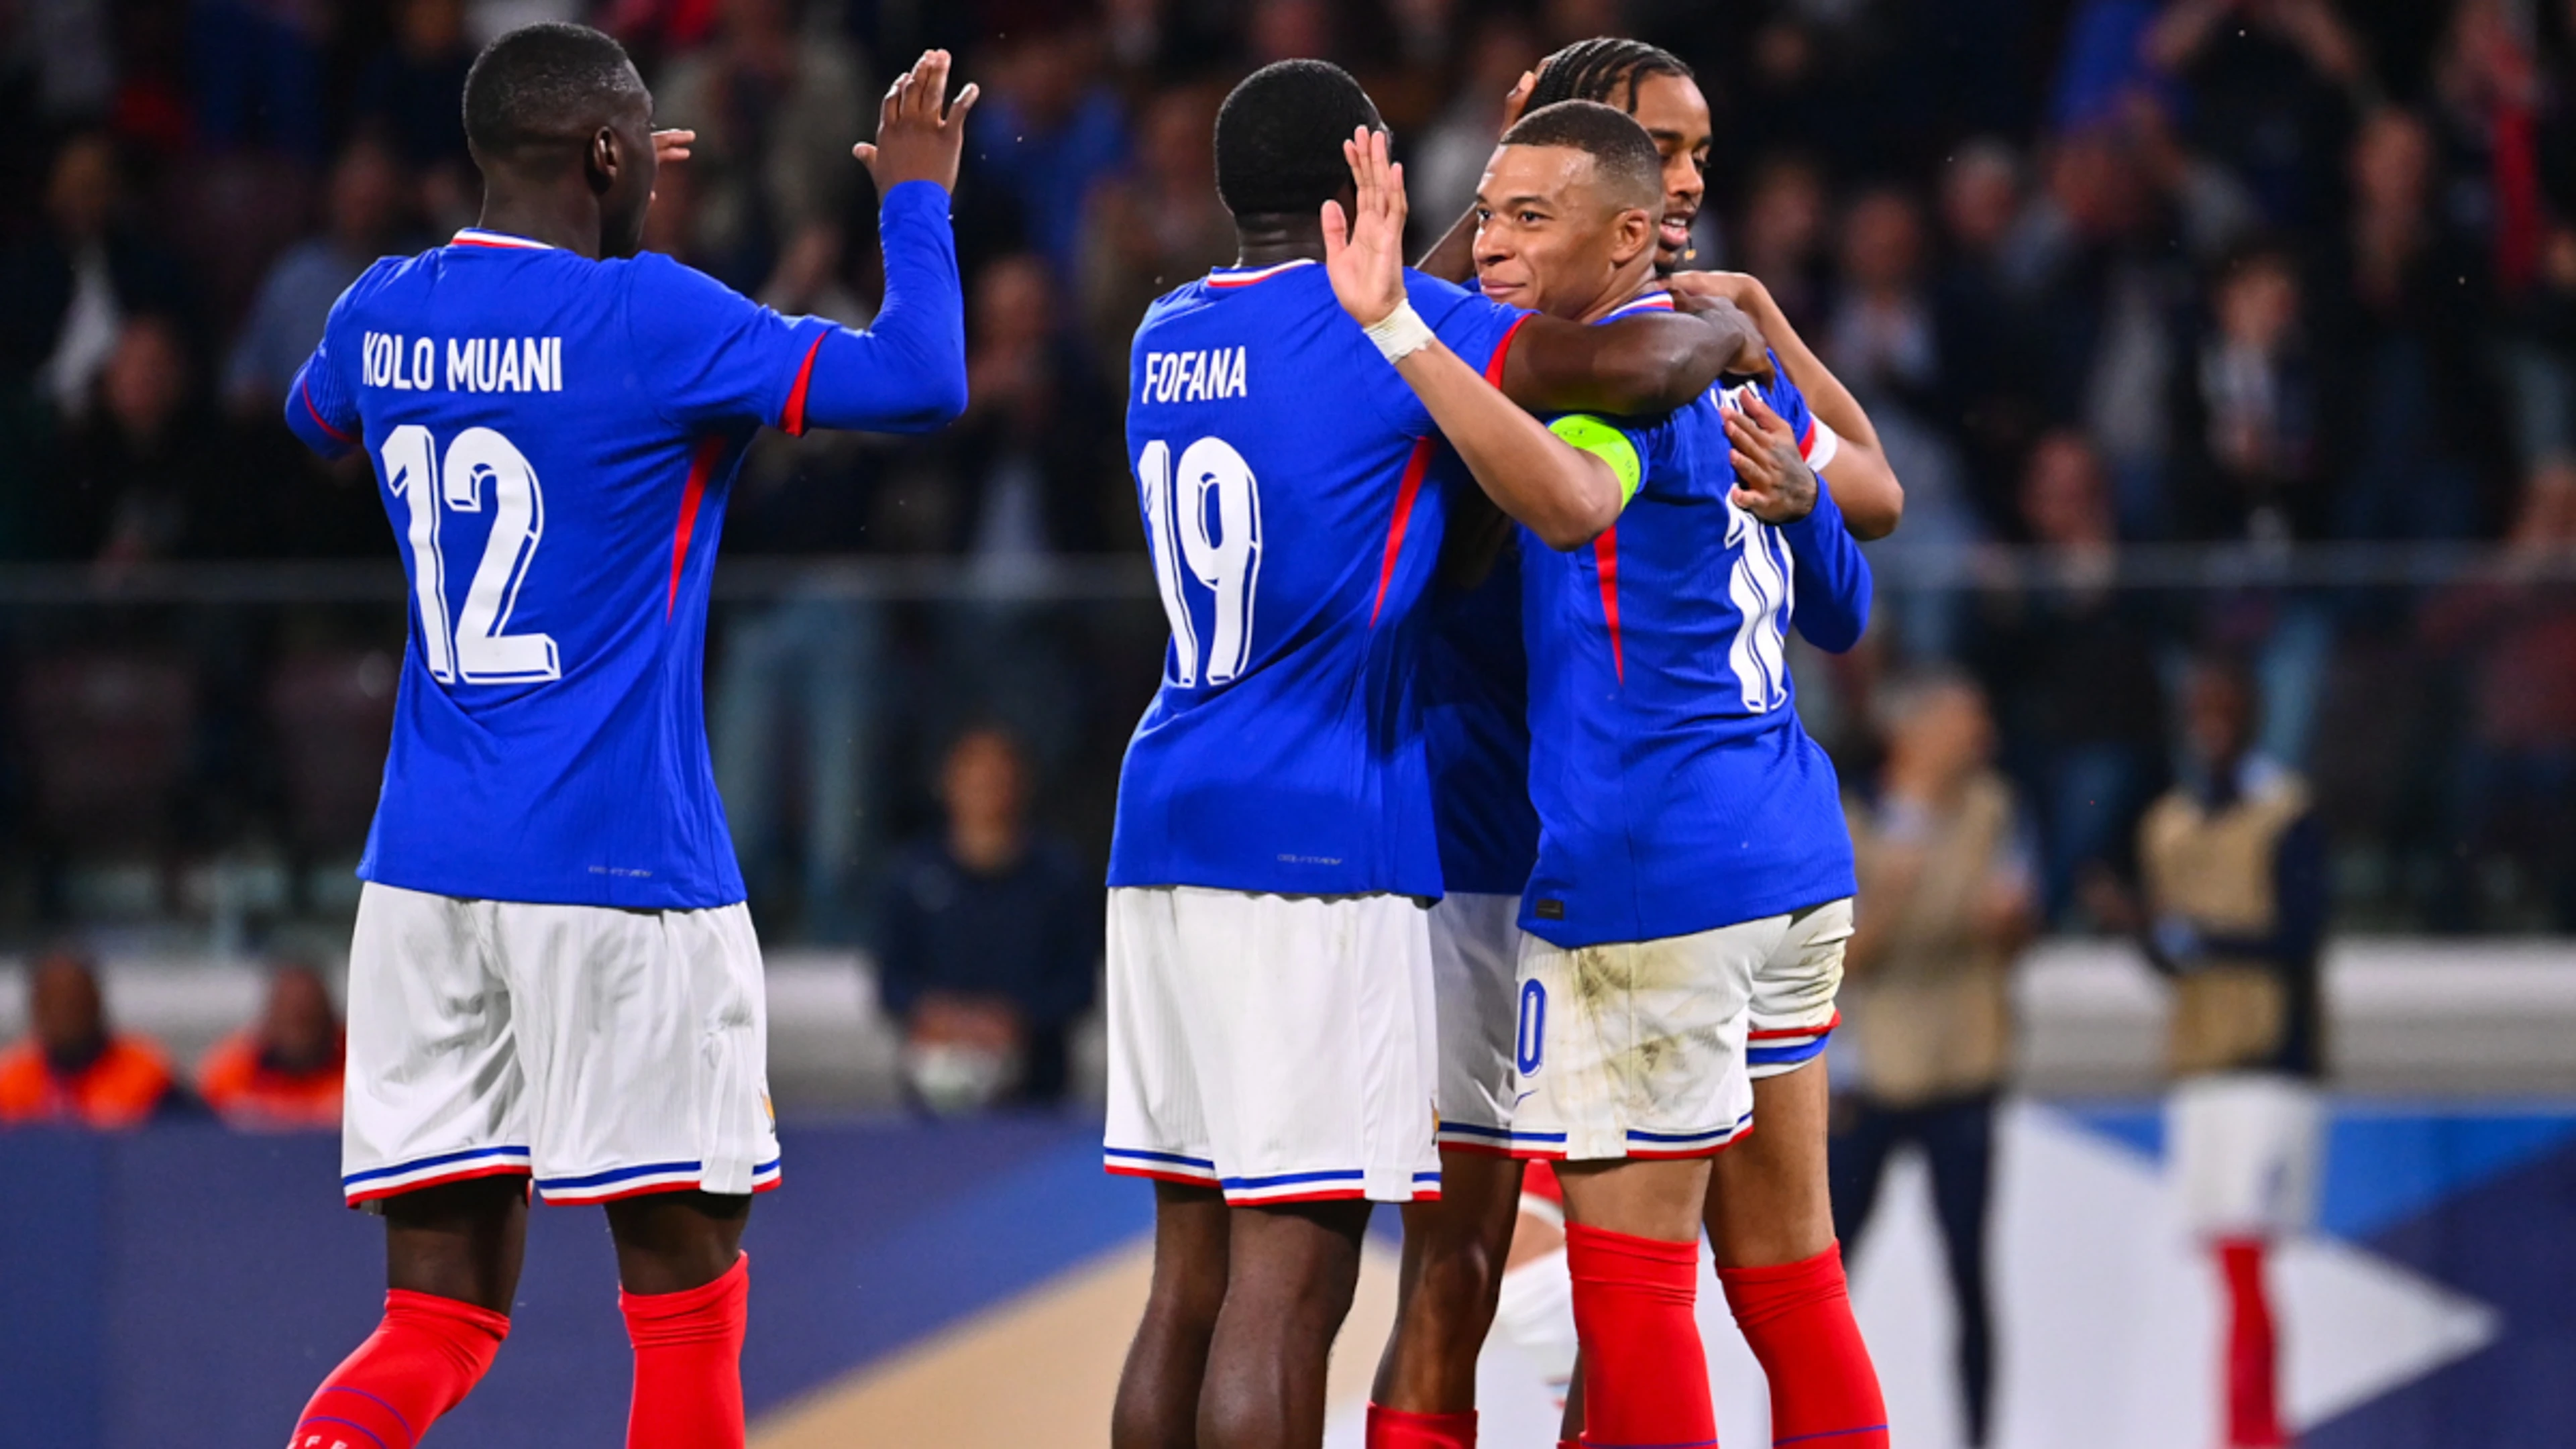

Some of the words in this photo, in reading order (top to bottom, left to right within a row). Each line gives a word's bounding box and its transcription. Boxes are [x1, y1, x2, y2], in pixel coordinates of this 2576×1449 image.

[363, 331, 434, 390] KOLO
[446, 337, 562, 392] MUANI
[1142, 345, 1247, 404] FOFANA
[381, 425, 561, 684] 12
[1138, 436, 1263, 688] 19
